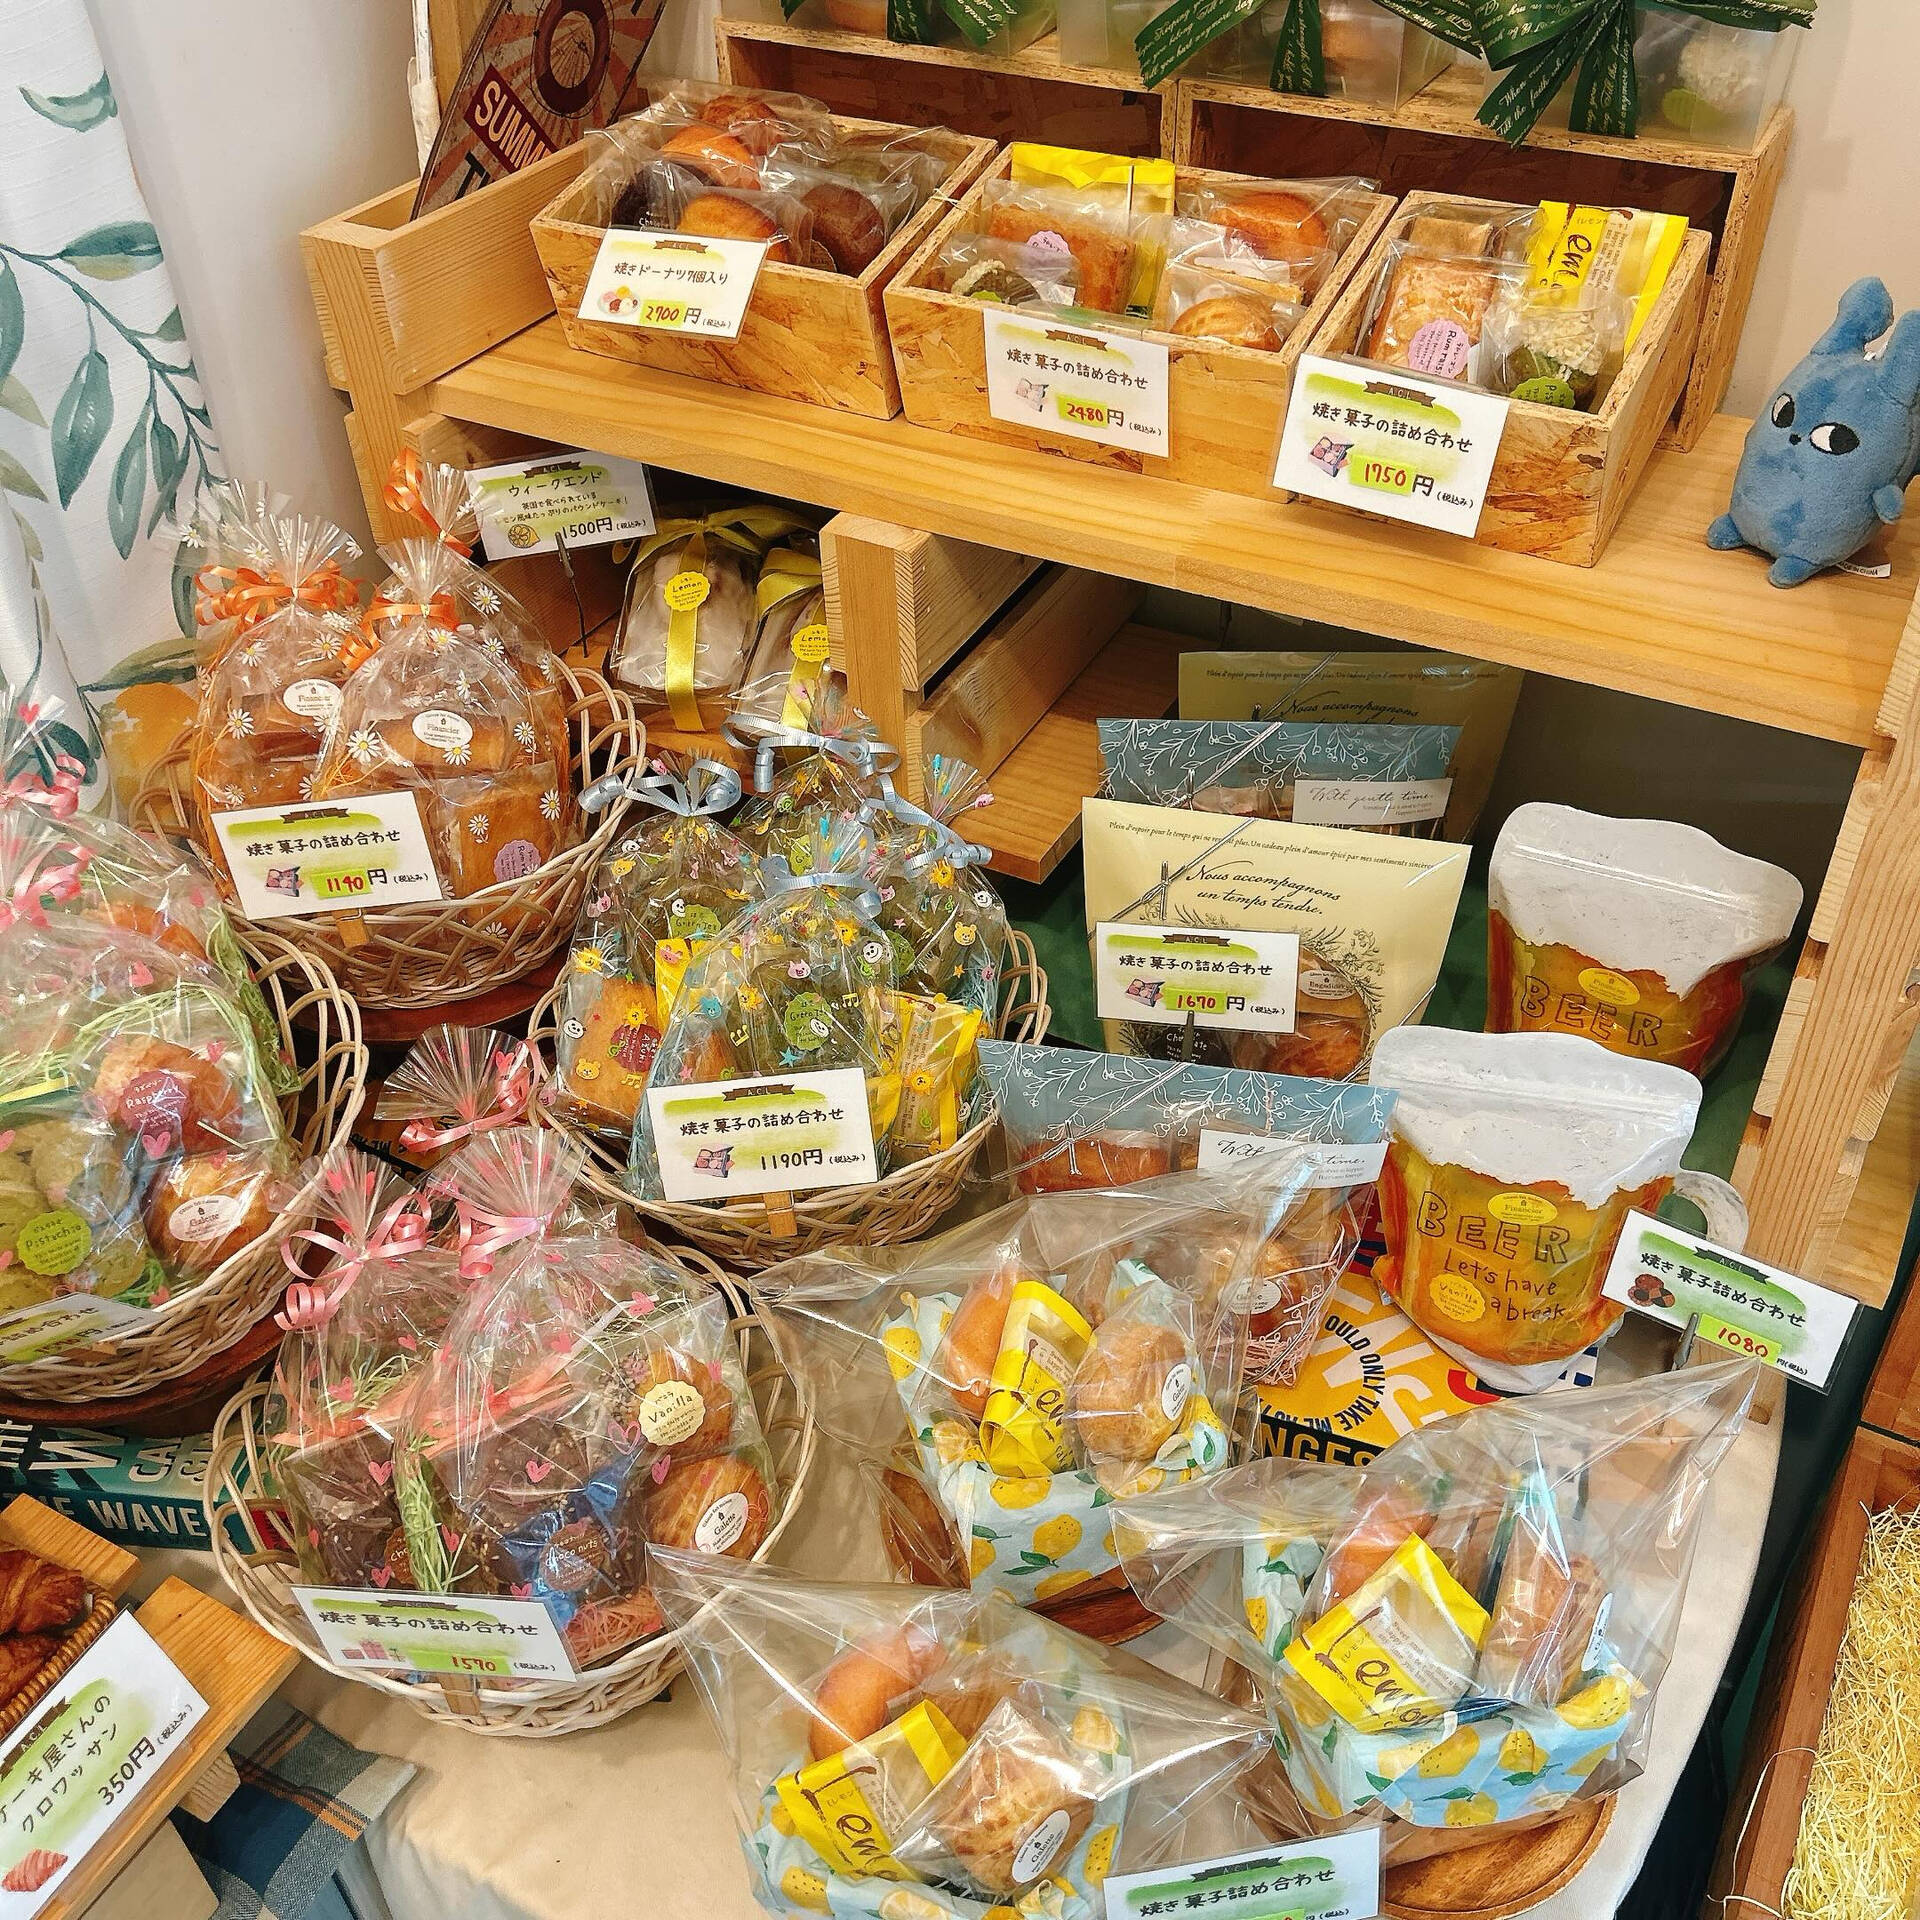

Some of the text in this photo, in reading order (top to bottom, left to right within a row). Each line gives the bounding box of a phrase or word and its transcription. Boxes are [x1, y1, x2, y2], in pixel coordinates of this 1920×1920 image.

[613, 262, 729, 285] 焼きドーナツ7個入り
[1006, 348, 1149, 390] 焼き菓子の詰め合わせ
[1312, 402, 1473, 454] 焼き菓子の詰め合わせ
[508, 471, 602, 498] ウィークエンド
[672, 580, 703, 592] Lemon
[801, 632, 829, 642] Lemo
[1322, 701, 1419, 718] accompagnons
[246, 828, 401, 857] 焼き菓子の詰め合わせ
[1150, 828, 1166, 837] pour
[1173, 831, 1191, 841] temps
[1191, 833, 1203, 842] qui
[1262, 842, 1284, 851] cadeau
[1284, 844, 1301, 856] plein
[1346, 854, 1359, 862] par
[1374, 857, 1408, 867] sentiments
[1186, 861, 1341, 901] Nous accompagnons
[1197, 891, 1222, 900] un
[1223, 888, 1268, 910] temps
[1119, 954, 1273, 977] 焼き菓子の詰め合わせ
[1521, 975, 1662, 1047] BEER
[680, 1107, 844, 1138] 焼き菓子の詰め合わせ
[1417, 1191, 1570, 1264] BEER
[1444, 1248, 1557, 1297] Let's have
[1640, 1251, 1806, 1329] 焼き菓子詰め合わせ
[1490, 1296, 1501, 1313] a
[1506, 1298, 1567, 1321] break
[1359, 1353, 1385, 1395] ONLY
[648, 1395, 693, 1423] Vanilla
[1334, 1395, 1379, 1432] TAKE
[87, 1499, 209, 1537] WAVE
[714, 1513, 736, 1536] Galette
[318, 1610, 539, 1636] 焼き菓子の詰め合わせ
[22, 1723, 117, 1833] クロワッサン
[1139, 1869, 1336, 1918] 焼き菓子詰め合わせ
